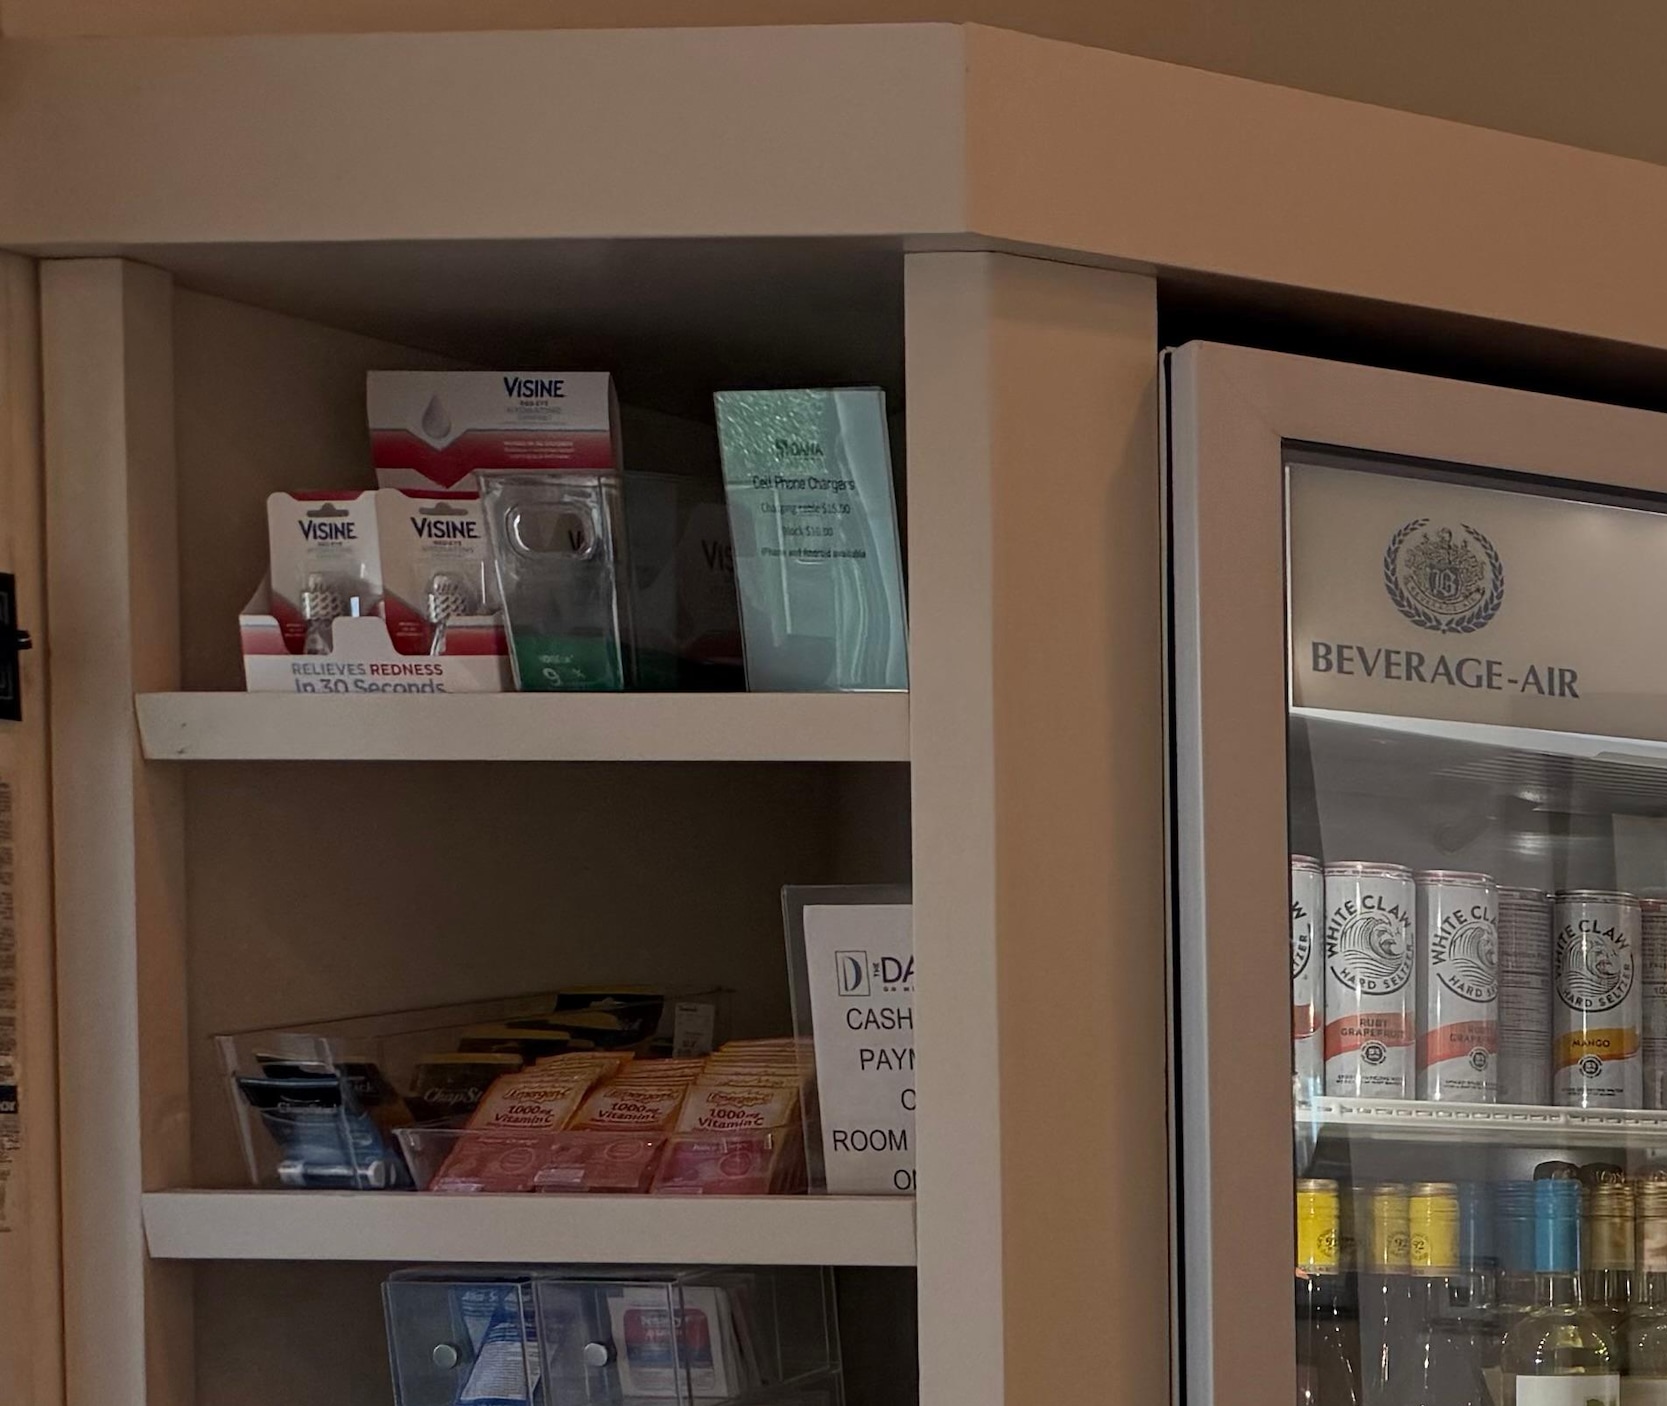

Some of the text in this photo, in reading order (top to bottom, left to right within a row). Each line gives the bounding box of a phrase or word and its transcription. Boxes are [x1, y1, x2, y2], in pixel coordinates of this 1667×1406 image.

[503, 377, 564, 398] VISINE
[774, 475, 805, 490] Phone
[808, 476, 856, 493] Chargers
[298, 520, 357, 540] VISINE
[410, 517, 480, 539] VISINE
[291, 662, 443, 676] RELIEVES REDNESS
[1311, 640, 1580, 699] BEVERAGE-AIR
[1327, 894, 1412, 959] WHITE CLAW
[1431, 909, 1468, 966] WHITE
[1578, 919, 1630, 950] CLAW
[1448, 975, 1483, 998] HARD
[846, 1007, 914, 1030] CASH
[1571, 1039, 1611, 1048] MANGO
[859, 1048, 915, 1071] PAY
[832, 1129, 908, 1152] ROOM
